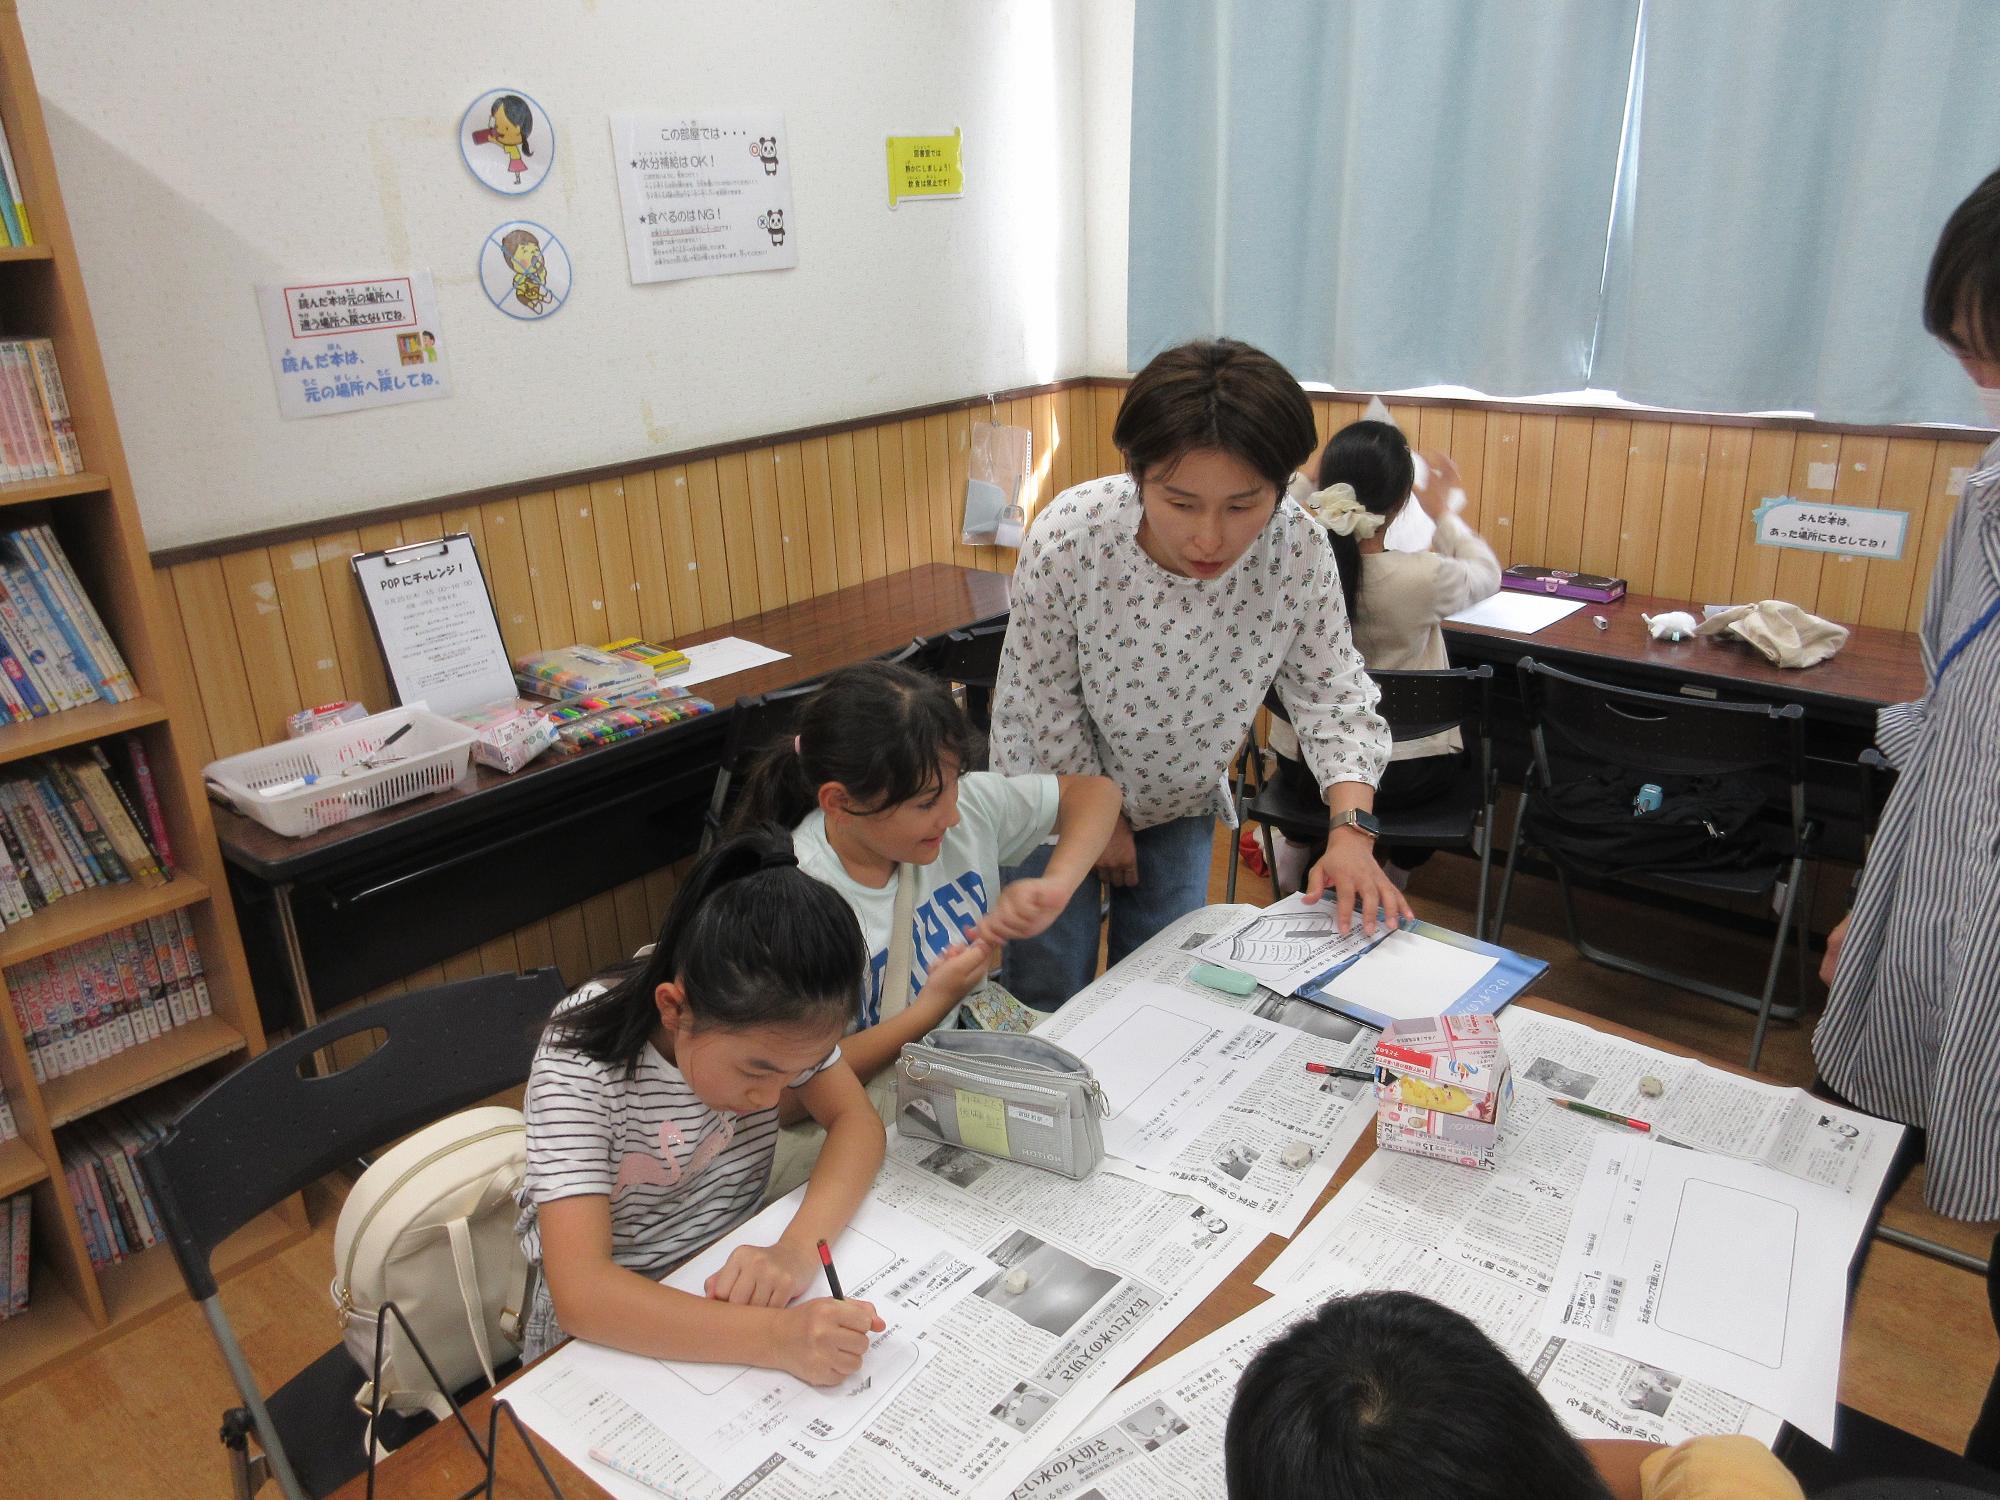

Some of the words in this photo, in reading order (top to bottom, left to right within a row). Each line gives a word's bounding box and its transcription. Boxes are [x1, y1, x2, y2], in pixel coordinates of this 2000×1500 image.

[281, 351, 365, 374] 読んだ本は、
[304, 371, 441, 403] 元の場所へ戻してね。
[1798, 513, 1850, 527] よんだ本は、
[1769, 527, 1888, 548] あった場所にもどしてね！
[1060, 1298, 1150, 1383] 伝えたい水の大切さ
